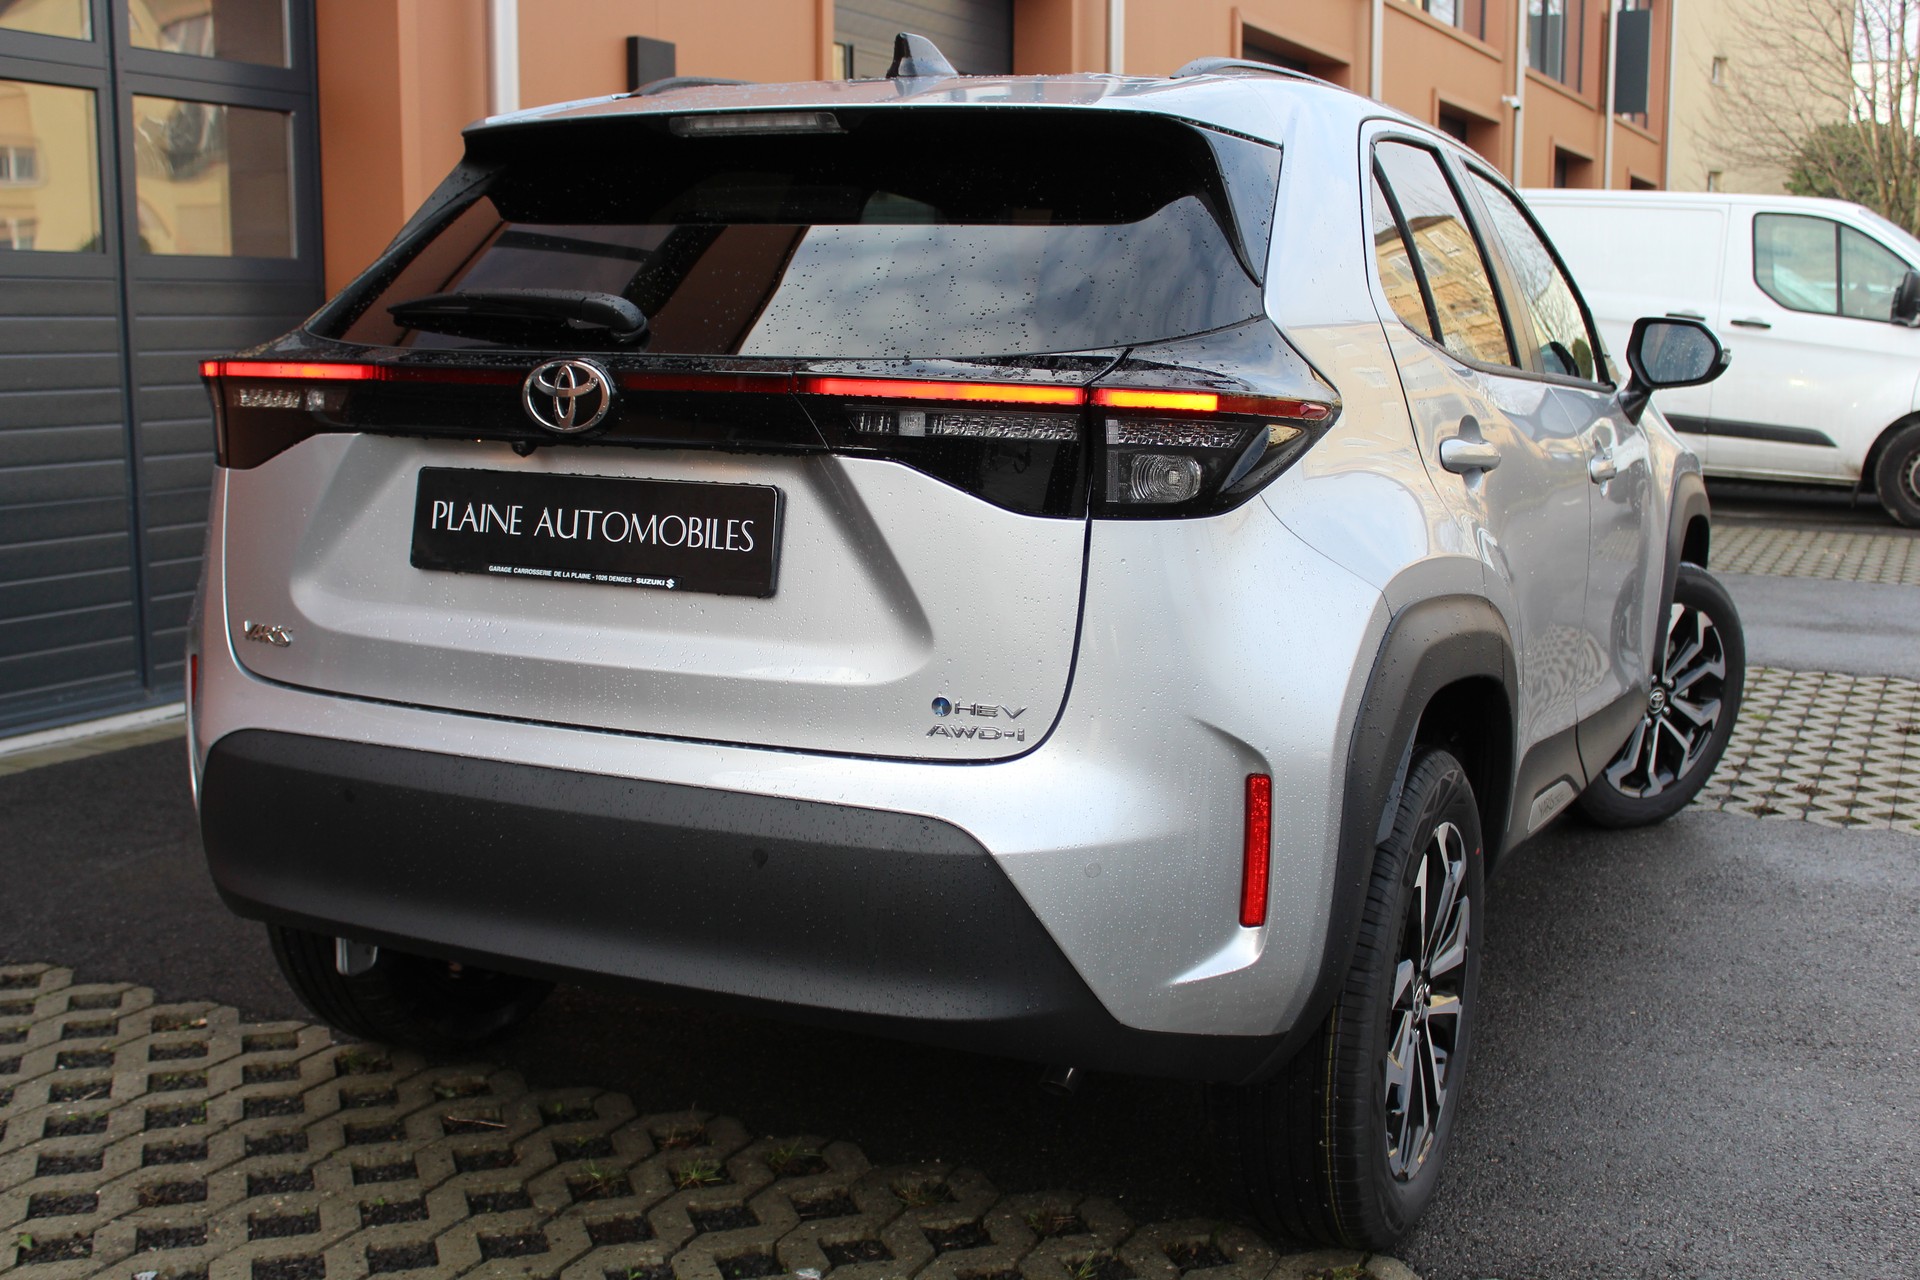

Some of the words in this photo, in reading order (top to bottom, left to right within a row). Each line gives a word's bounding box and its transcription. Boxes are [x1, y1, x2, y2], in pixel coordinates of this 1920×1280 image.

[431, 500, 524, 536] PLAINE
[533, 506, 755, 553] AUTOMOBILES
[488, 565, 513, 574] GARAGE
[513, 567, 553, 577] CARROSSERIE
[571, 572, 592, 580] PLAINE
[608, 575, 633, 584] DENGES
[635, 577, 666, 586] SUZUKI
[954, 701, 1028, 720] HEV
